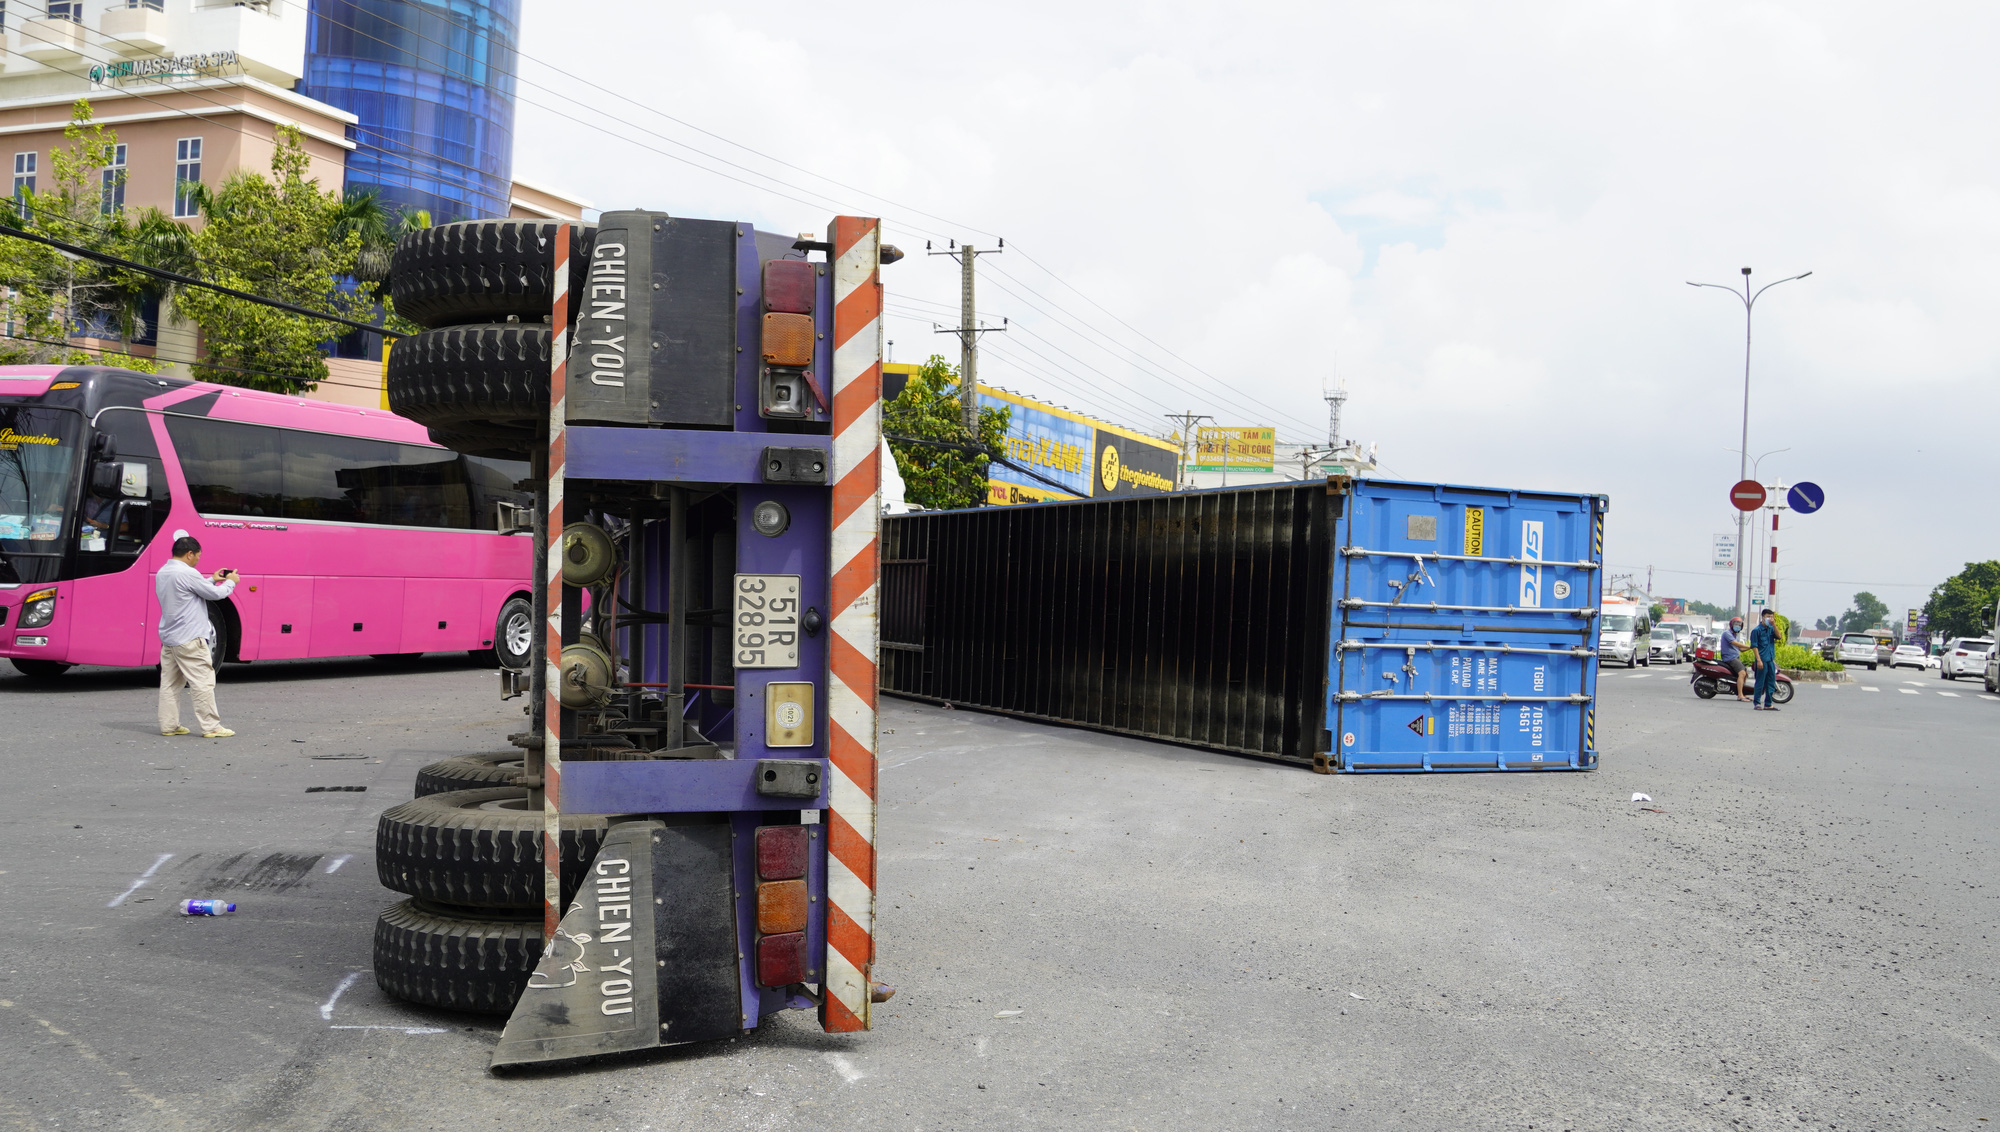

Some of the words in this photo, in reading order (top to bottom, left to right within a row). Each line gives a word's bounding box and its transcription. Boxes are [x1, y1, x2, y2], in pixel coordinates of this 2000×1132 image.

[210, 50, 237, 67] SPA
[591, 243, 625, 387] CHIEN-YOU
[1261, 431, 1272, 440] AN
[1471, 509, 1481, 555] CAUTION
[1525, 522, 1538, 606] SITC
[738, 578, 766, 665] 328.95
[768, 598, 796, 646] 51R
[1462, 657, 1472, 688] PAYLOAD
[1477, 678, 1485, 692] WT.
[1488, 678, 1497, 692] WT.
[1534, 665, 1545, 691] TGBU
[1520, 705, 1530, 732] 45G1
[1531, 706, 1543, 746] 705630
[1532, 753, 1543, 762] 5
[596, 859, 633, 1016] CHIEN-YOU
